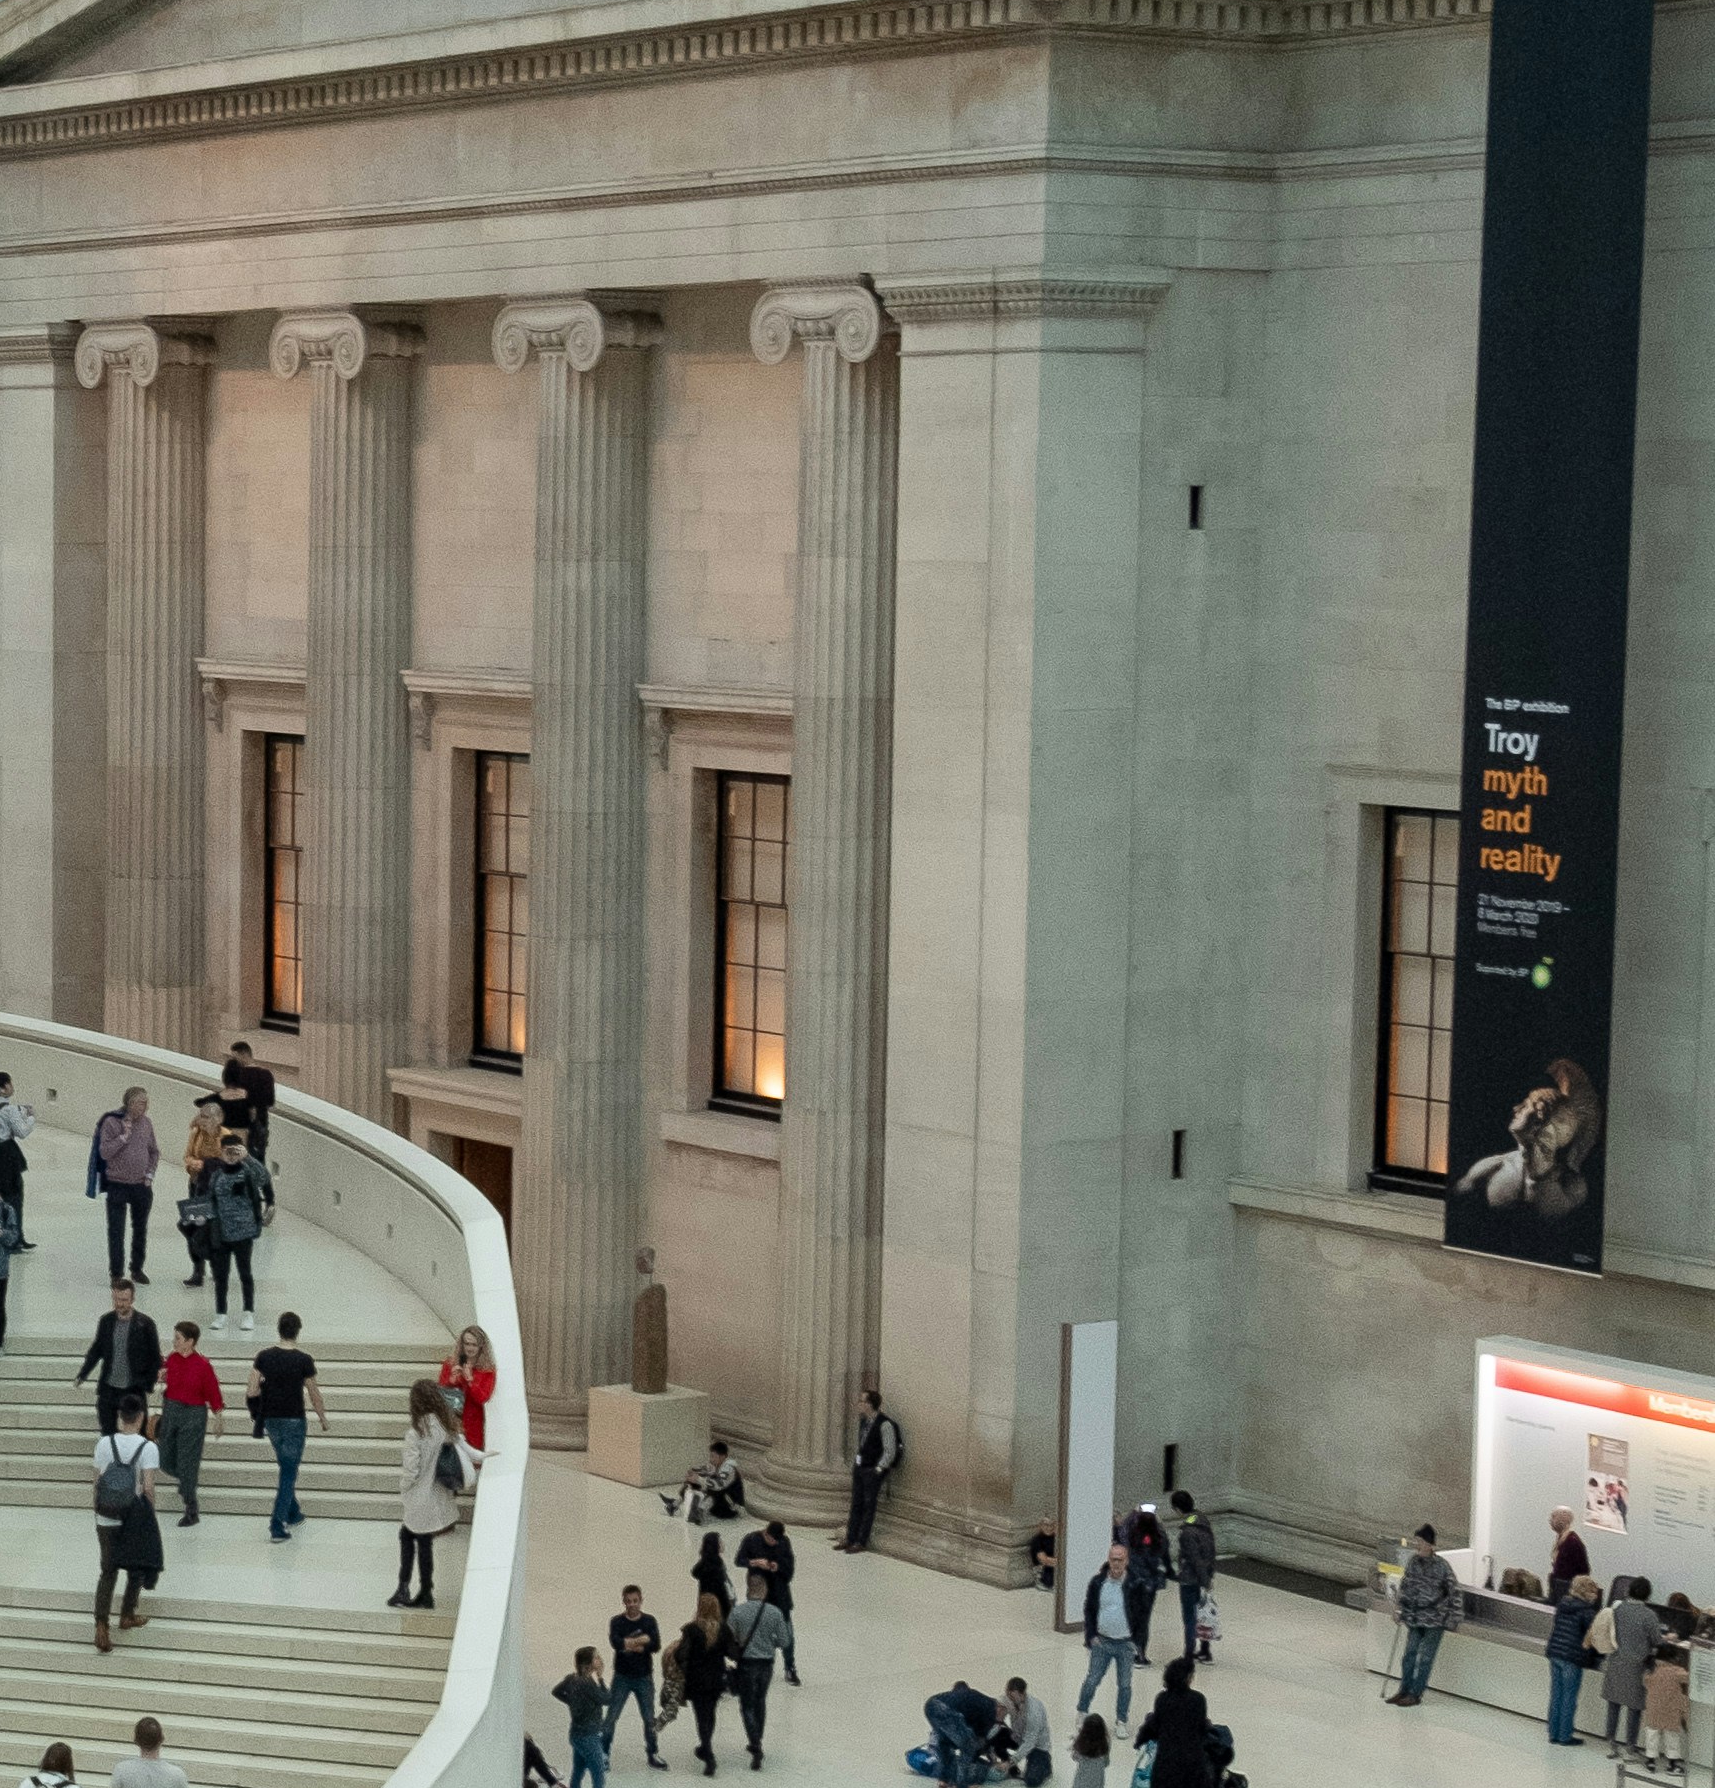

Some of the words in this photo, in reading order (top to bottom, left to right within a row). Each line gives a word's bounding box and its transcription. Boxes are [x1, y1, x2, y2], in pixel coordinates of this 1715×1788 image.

[1484, 723, 1540, 762] Troy
[1483, 765, 1548, 800] myth
[1481, 805, 1532, 834] and
[1480, 843, 1561, 883] reality
